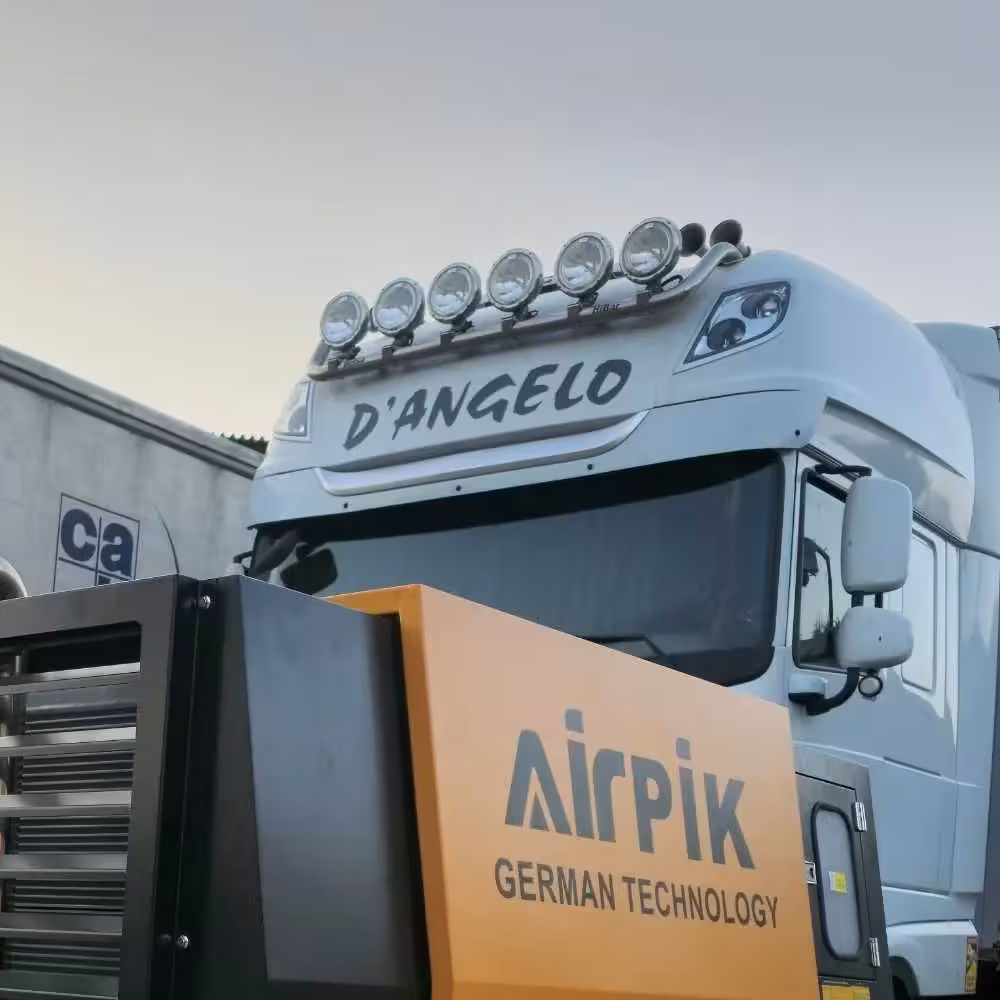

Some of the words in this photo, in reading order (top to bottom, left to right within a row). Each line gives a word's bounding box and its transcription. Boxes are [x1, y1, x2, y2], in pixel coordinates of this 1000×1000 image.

[343, 358, 632, 450] D'ANGELO
[494, 857, 616, 911] GERMAN
[621, 876, 778, 929] TECHNOLOGY
